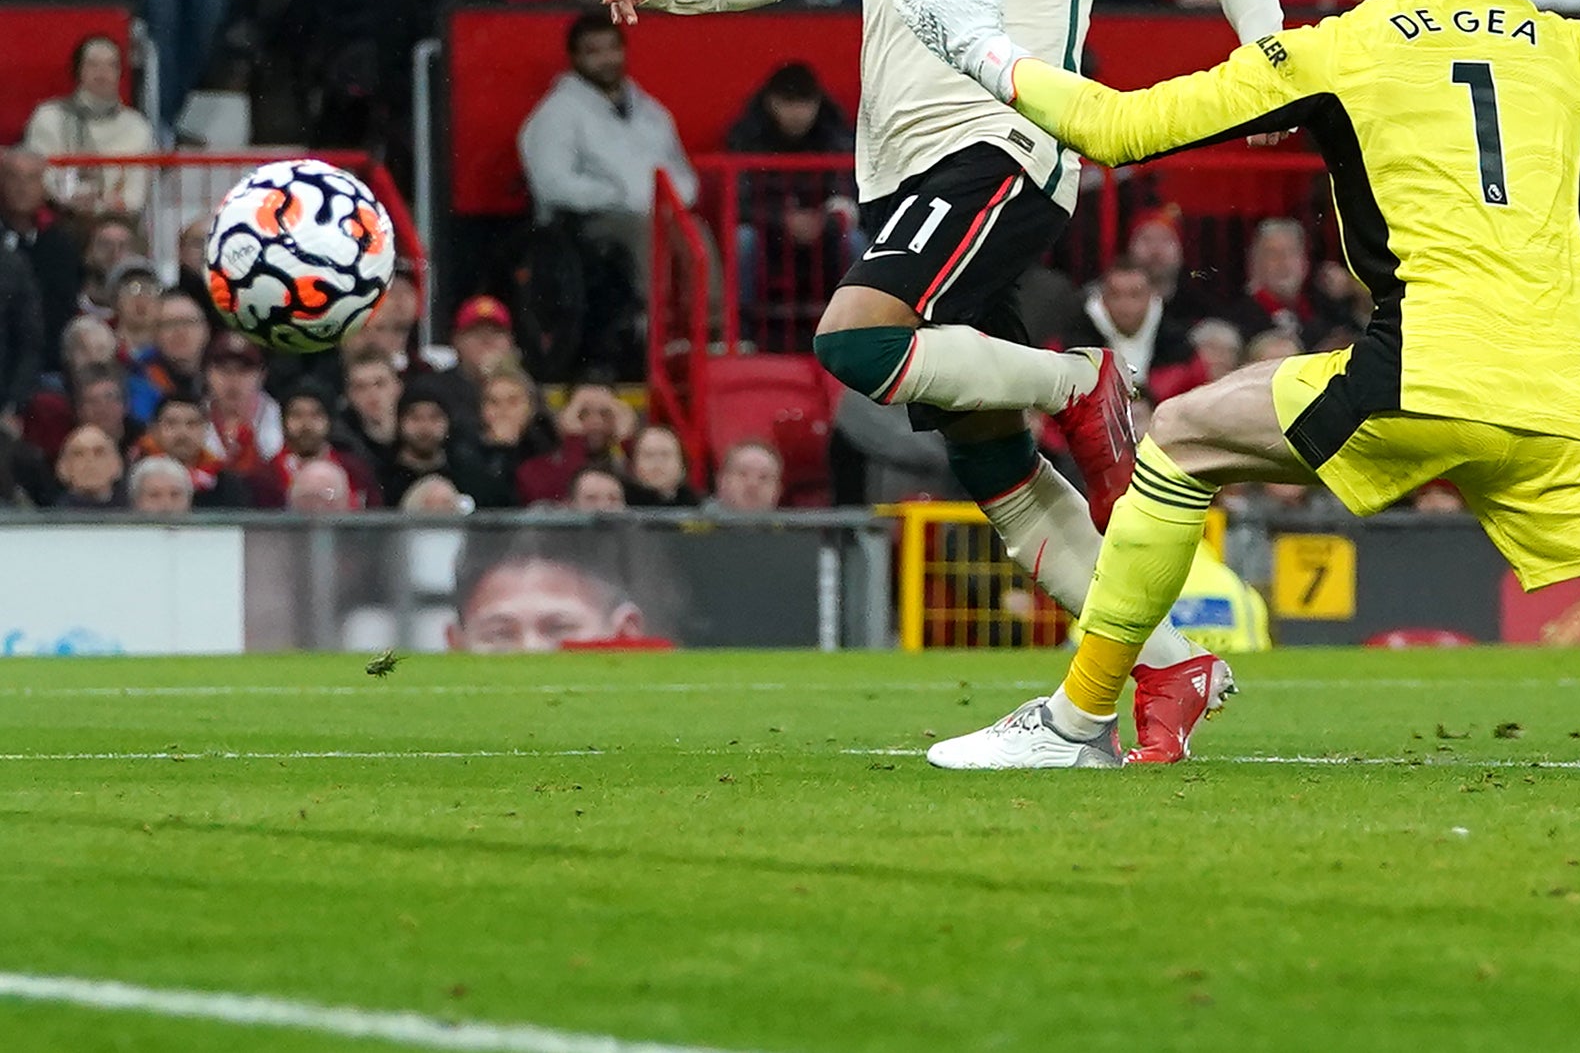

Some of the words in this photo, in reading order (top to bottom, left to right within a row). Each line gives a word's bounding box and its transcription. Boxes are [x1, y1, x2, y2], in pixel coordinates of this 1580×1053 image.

[1390, 9, 1442, 40] DE
[1453, 9, 1536, 45] GEA
[1451, 61, 1509, 207] 1
[874, 194, 953, 255] 11
